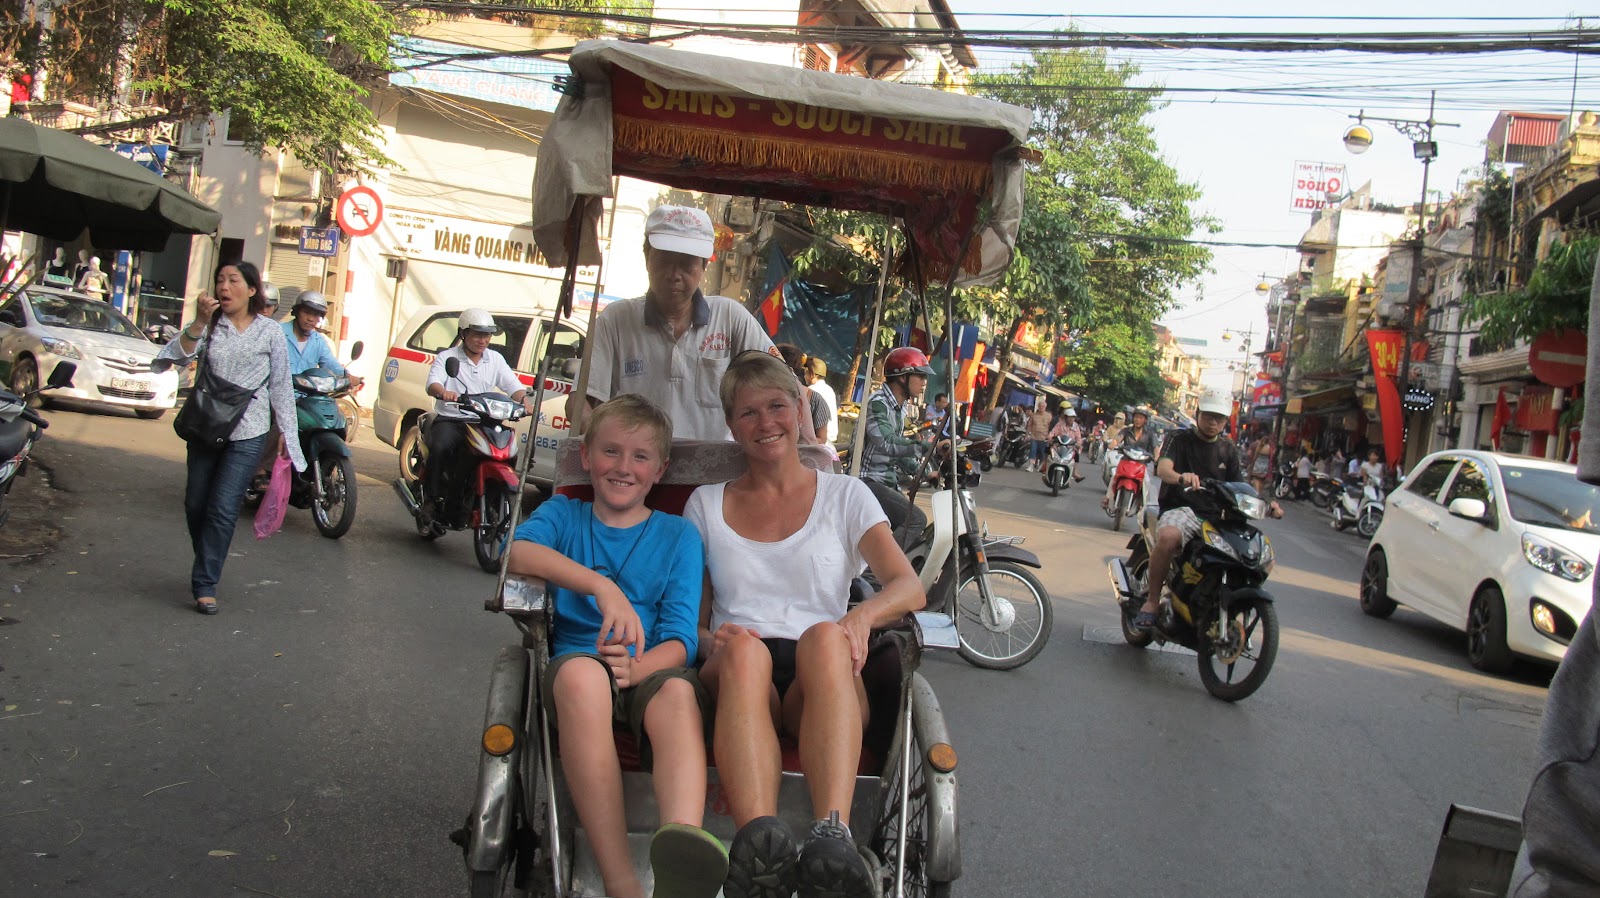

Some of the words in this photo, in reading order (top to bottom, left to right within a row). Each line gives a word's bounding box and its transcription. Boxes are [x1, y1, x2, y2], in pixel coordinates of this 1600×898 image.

[642, 78, 736, 119] SANS
[771, 99, 873, 137] SOUCI
[883, 117, 967, 150] SARL
[434, 226, 472, 255] VÀNG
[474, 236, 523, 263] QUANG
[624, 359, 643, 374] UNESCO
